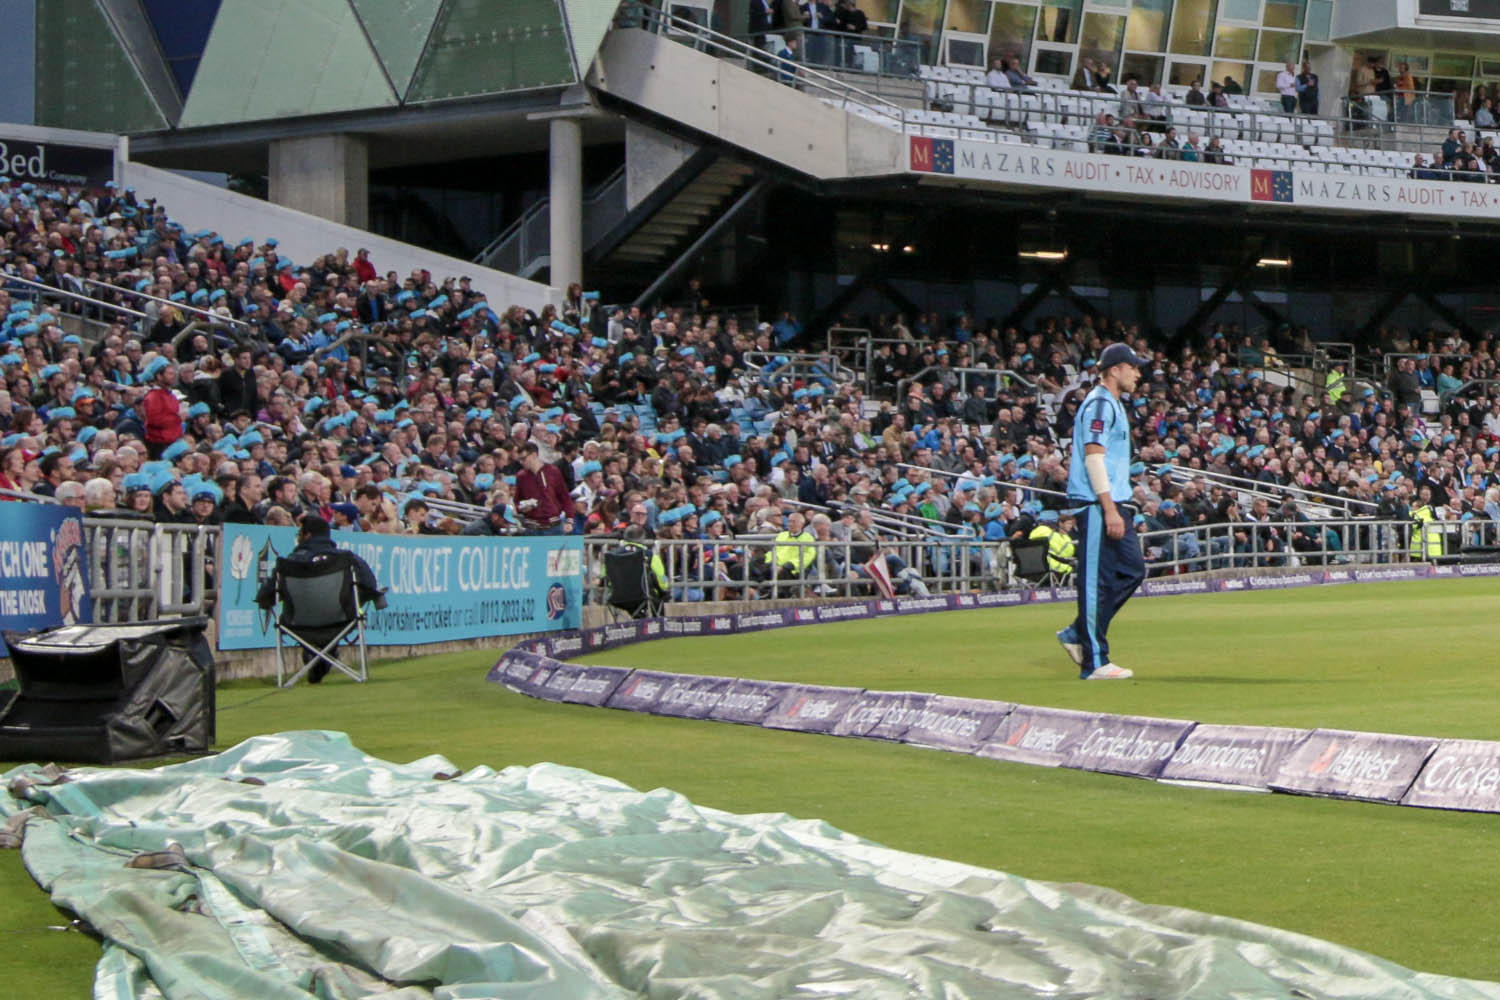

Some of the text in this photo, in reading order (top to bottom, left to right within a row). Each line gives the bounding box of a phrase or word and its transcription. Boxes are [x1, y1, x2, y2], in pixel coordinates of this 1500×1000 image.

[913, 145, 929, 165] M
[961, 150, 1241, 192] MAZARS AUDIT TAX ADVISORY
[1254, 174, 1270, 194] M
[1301, 179, 1390, 202] MAZARS
[1398, 187, 1444, 206] AUDIT
[1461, 191, 1488, 207] TAX
[23, 541, 48, 578] ONE
[390, 545, 453, 595] CRICKET
[458, 546, 530, 591] COLLEGE
[19, 590, 46, 615] KIOSK
[1327, 748, 1398, 781] NatWest
